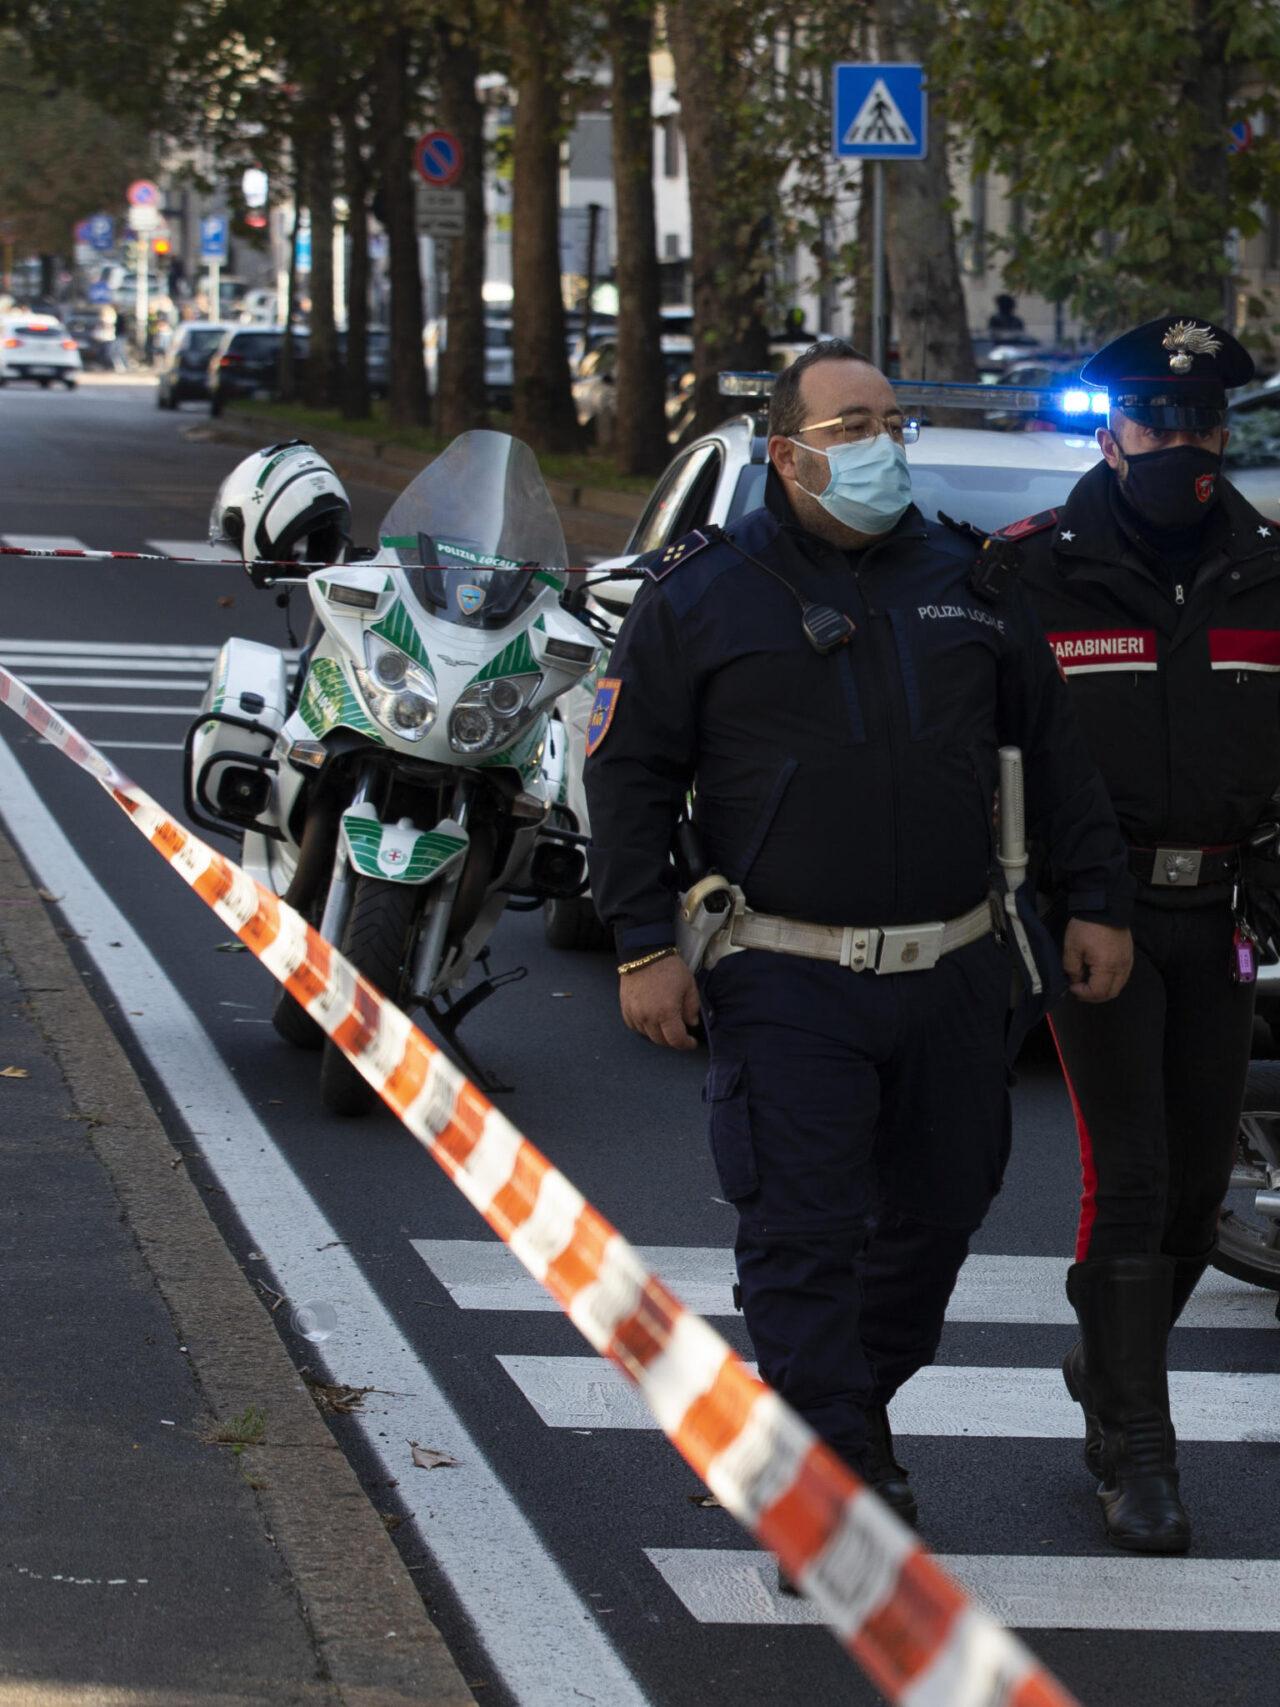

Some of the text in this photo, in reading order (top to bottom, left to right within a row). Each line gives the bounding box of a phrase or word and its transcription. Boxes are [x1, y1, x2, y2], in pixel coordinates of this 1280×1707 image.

[437, 542, 518, 569] POLIZIA LOCALE
[917, 605, 966, 620] POLIZIA
[1048, 637, 1144, 658] ARABINIERI
